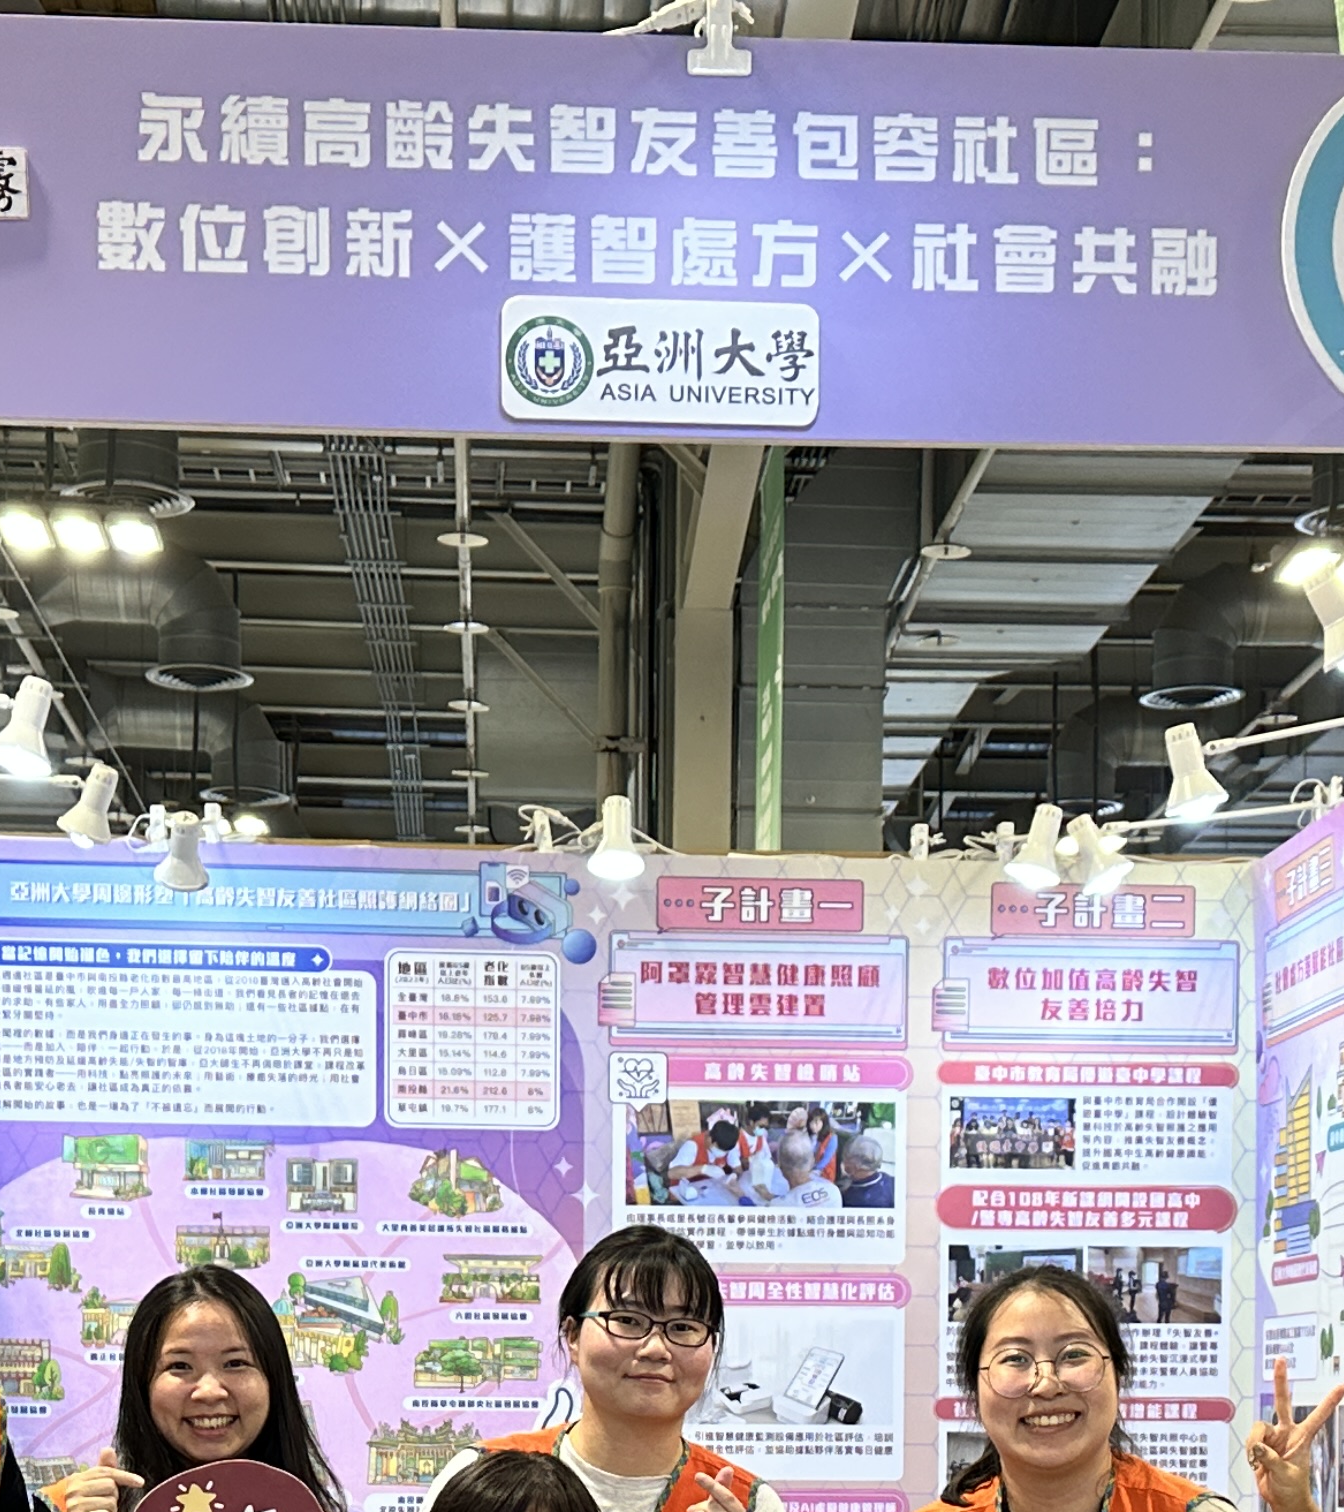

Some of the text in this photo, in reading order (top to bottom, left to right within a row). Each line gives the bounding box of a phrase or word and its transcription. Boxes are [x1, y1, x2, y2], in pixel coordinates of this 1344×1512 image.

[138, 91, 1154, 187] 永續高齡失智友善包容社區：
[597, 326, 814, 382] 亞洲大學
[600, 382, 656, 403] ASIA
[669, 383, 815, 406] UNIVERSITY
[700, 885, 853, 924] 子計畫一
[1033, 890, 1185, 930] 子計畫二
[987, 966, 1198, 992] 數位加值高齡失智
[695, 992, 826, 1017] 管理雲建置
[1040, 998, 1144, 1023] 友善培力
